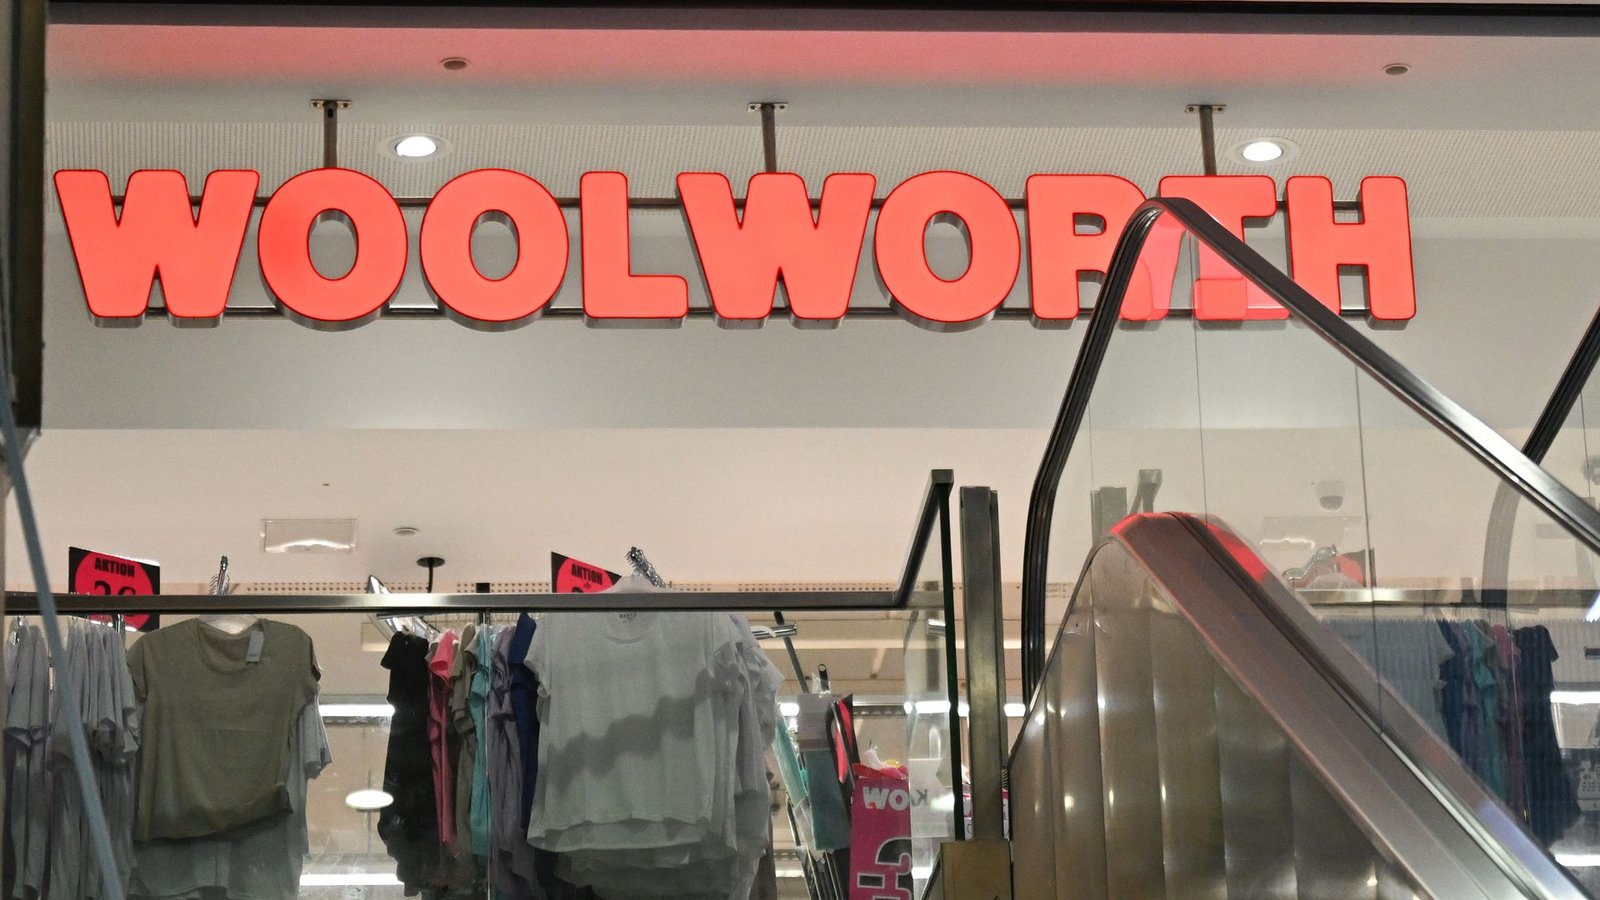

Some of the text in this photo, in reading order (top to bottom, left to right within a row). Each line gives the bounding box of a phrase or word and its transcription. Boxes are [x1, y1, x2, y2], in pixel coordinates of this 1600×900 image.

[54, 168, 1417, 325] WOOLWORTH
[94, 557, 135, 578] AKTION
[571, 563, 603, 585] AKTION
